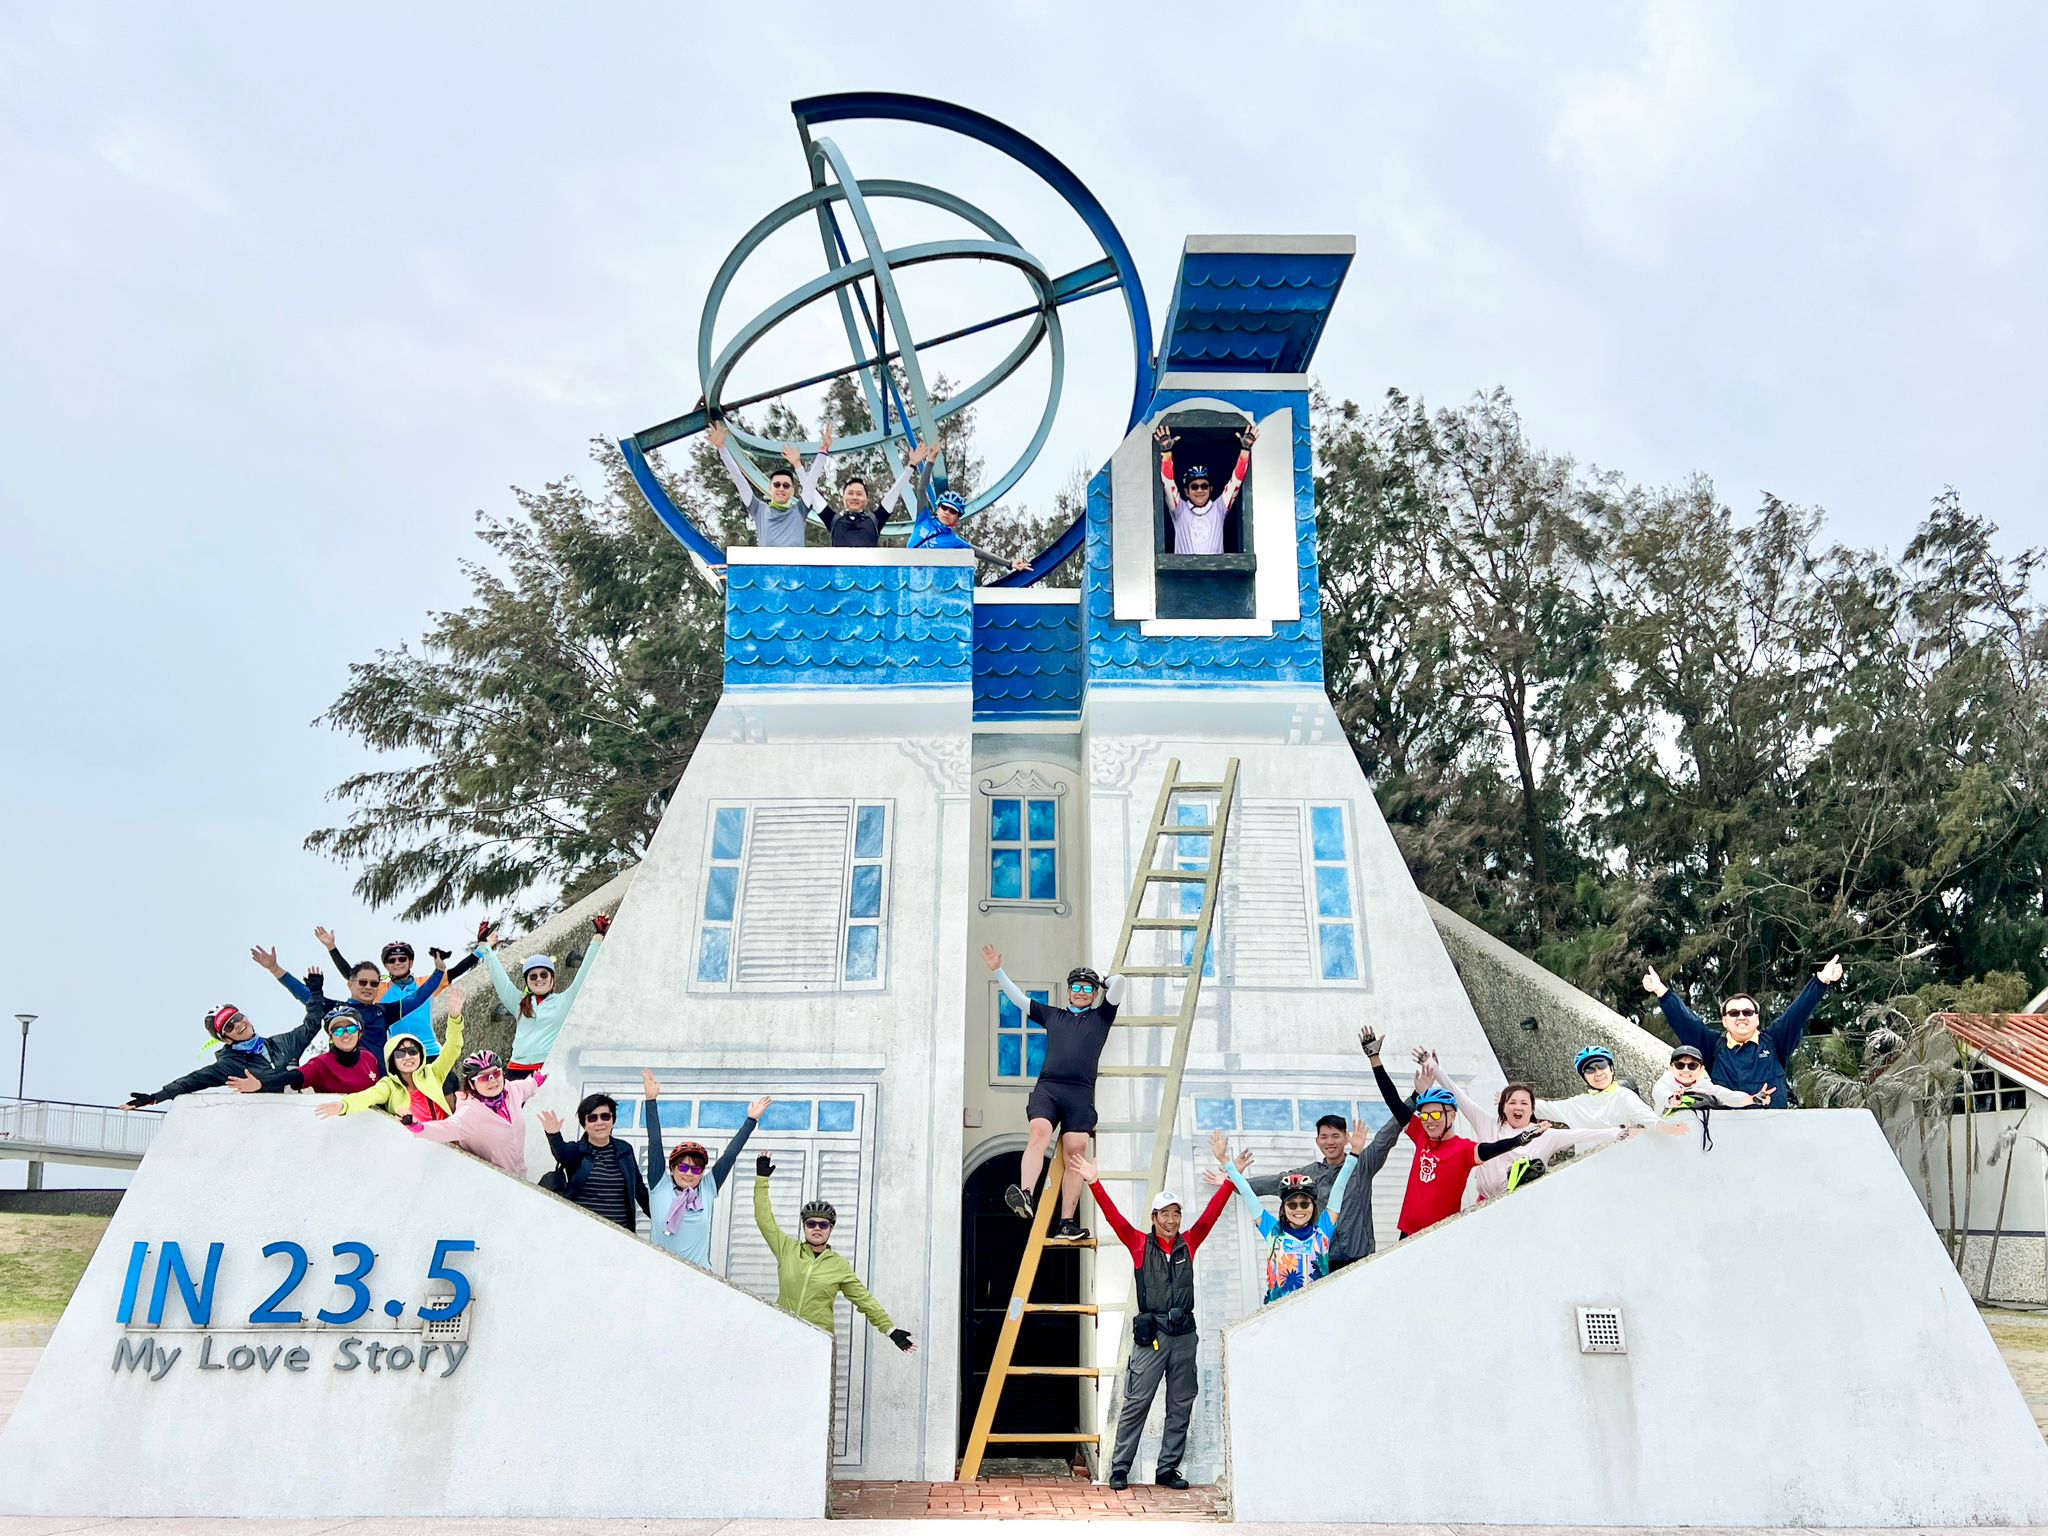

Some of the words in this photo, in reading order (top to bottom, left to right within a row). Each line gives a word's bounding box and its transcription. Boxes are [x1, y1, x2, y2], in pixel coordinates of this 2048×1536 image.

[116, 1241, 225, 1325] IN
[249, 1239, 476, 1325] 23.5
[111, 1337, 182, 1382] My
[200, 1335, 311, 1372] Love
[333, 1337, 469, 1378] Story
